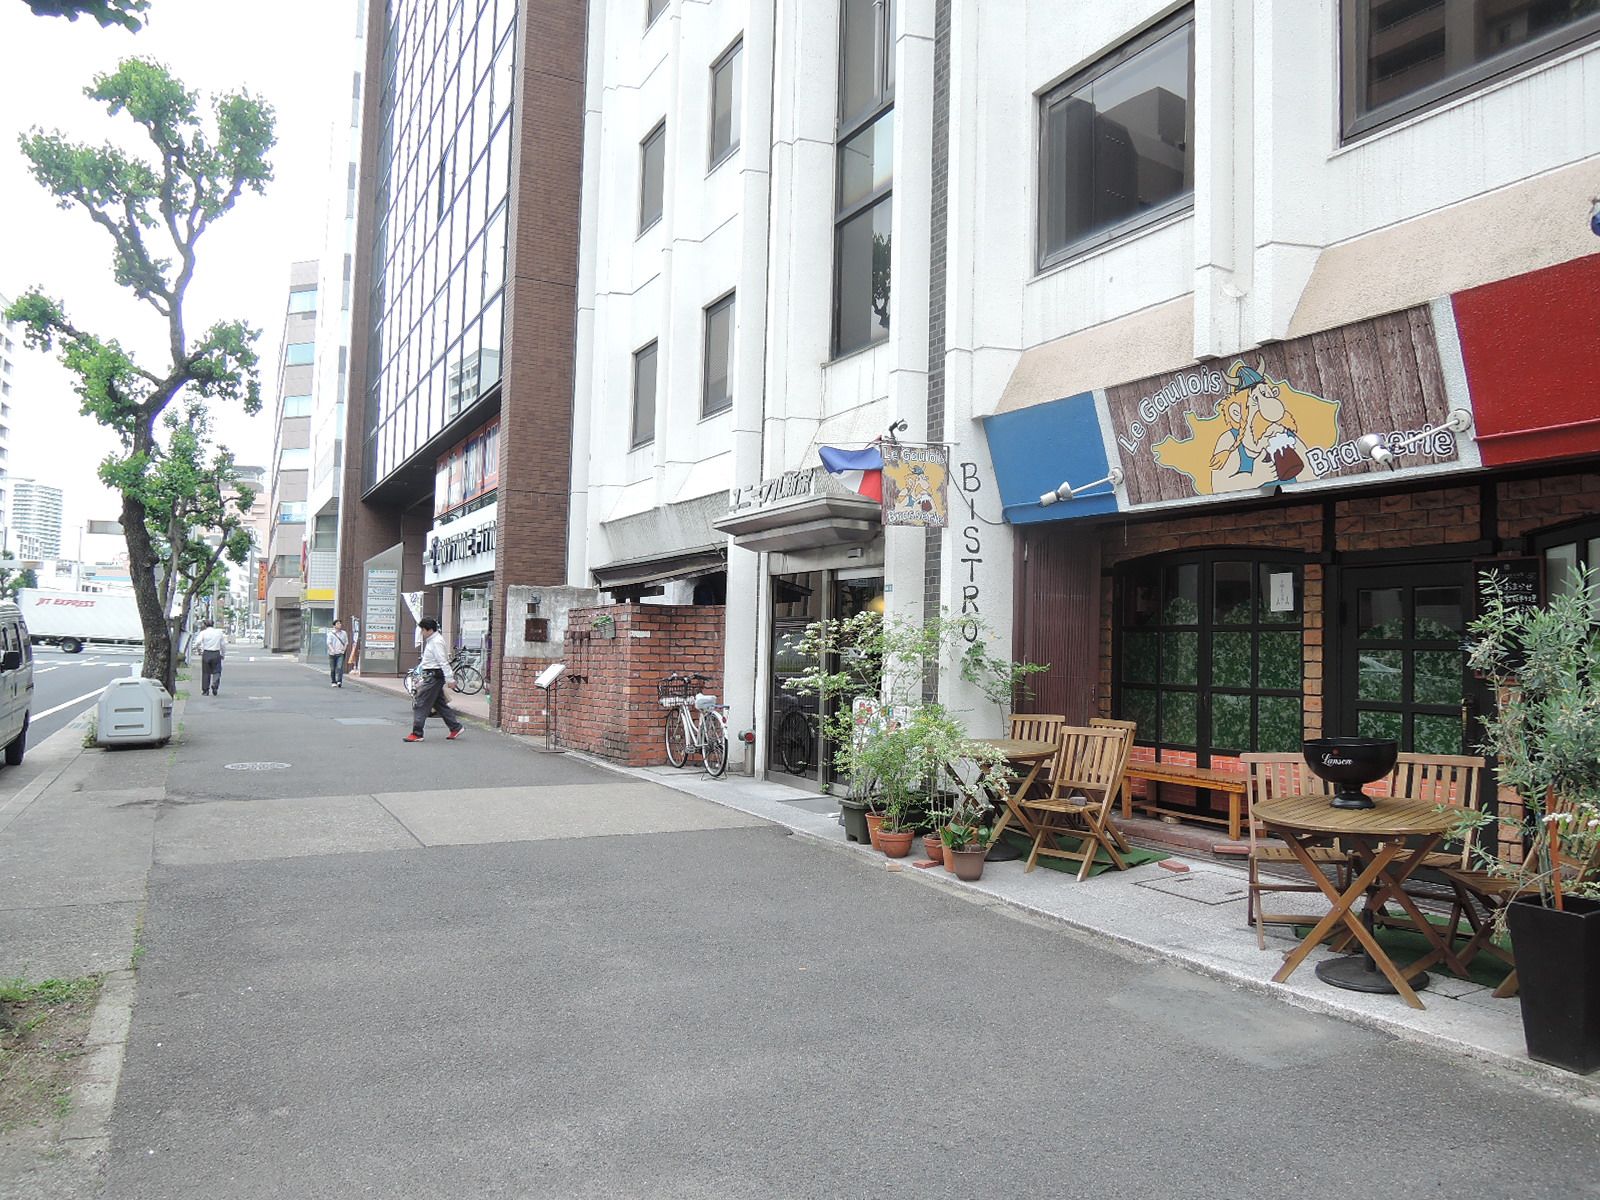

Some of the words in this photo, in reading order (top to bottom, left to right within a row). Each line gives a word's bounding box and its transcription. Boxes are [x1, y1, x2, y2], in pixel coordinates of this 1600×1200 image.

[1118, 421, 1147, 455] Le
[1138, 366, 1222, 424] Gaulois
[882, 446, 899, 460] Le
[903, 447, 946, 464] Gaulois
[1305, 424, 1454, 477] Braerie
[960, 462, 983, 643] BISTRO
[53, 598, 96, 607] EXPRESS
